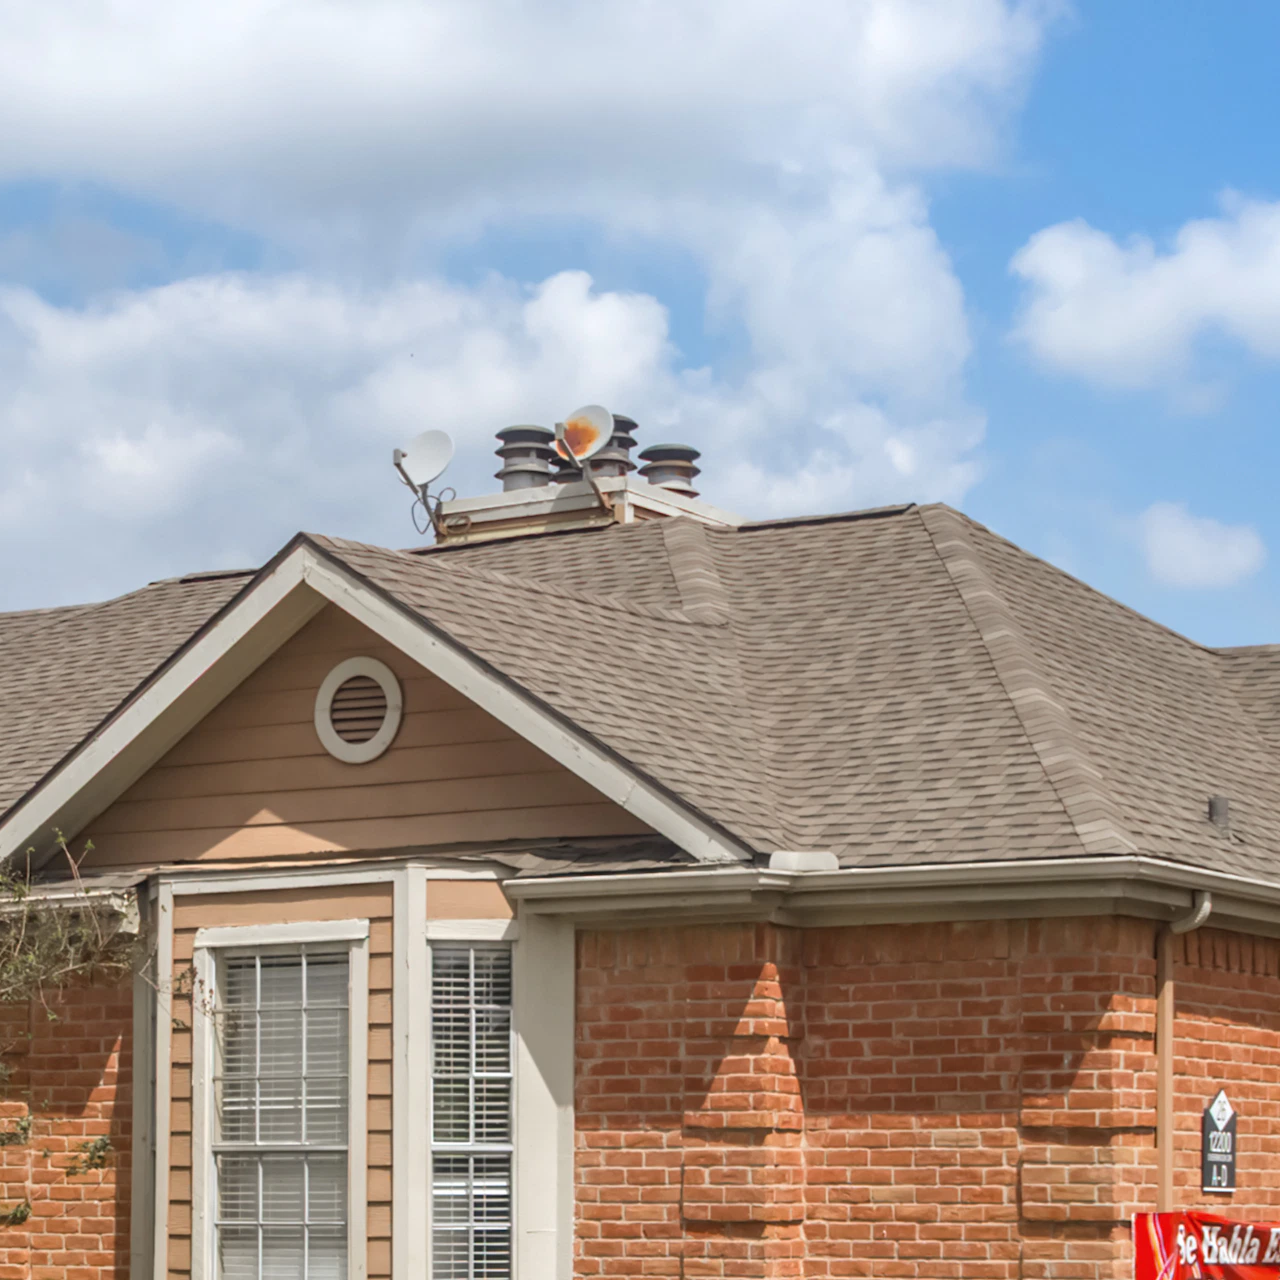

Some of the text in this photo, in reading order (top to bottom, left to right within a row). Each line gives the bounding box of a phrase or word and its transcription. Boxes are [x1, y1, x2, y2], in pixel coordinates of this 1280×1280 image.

[1209, 1131, 1232, 1153] 12200
[1211, 1164, 1228, 1187] A-D
[1201, 1224, 1261, 1265] Habla
